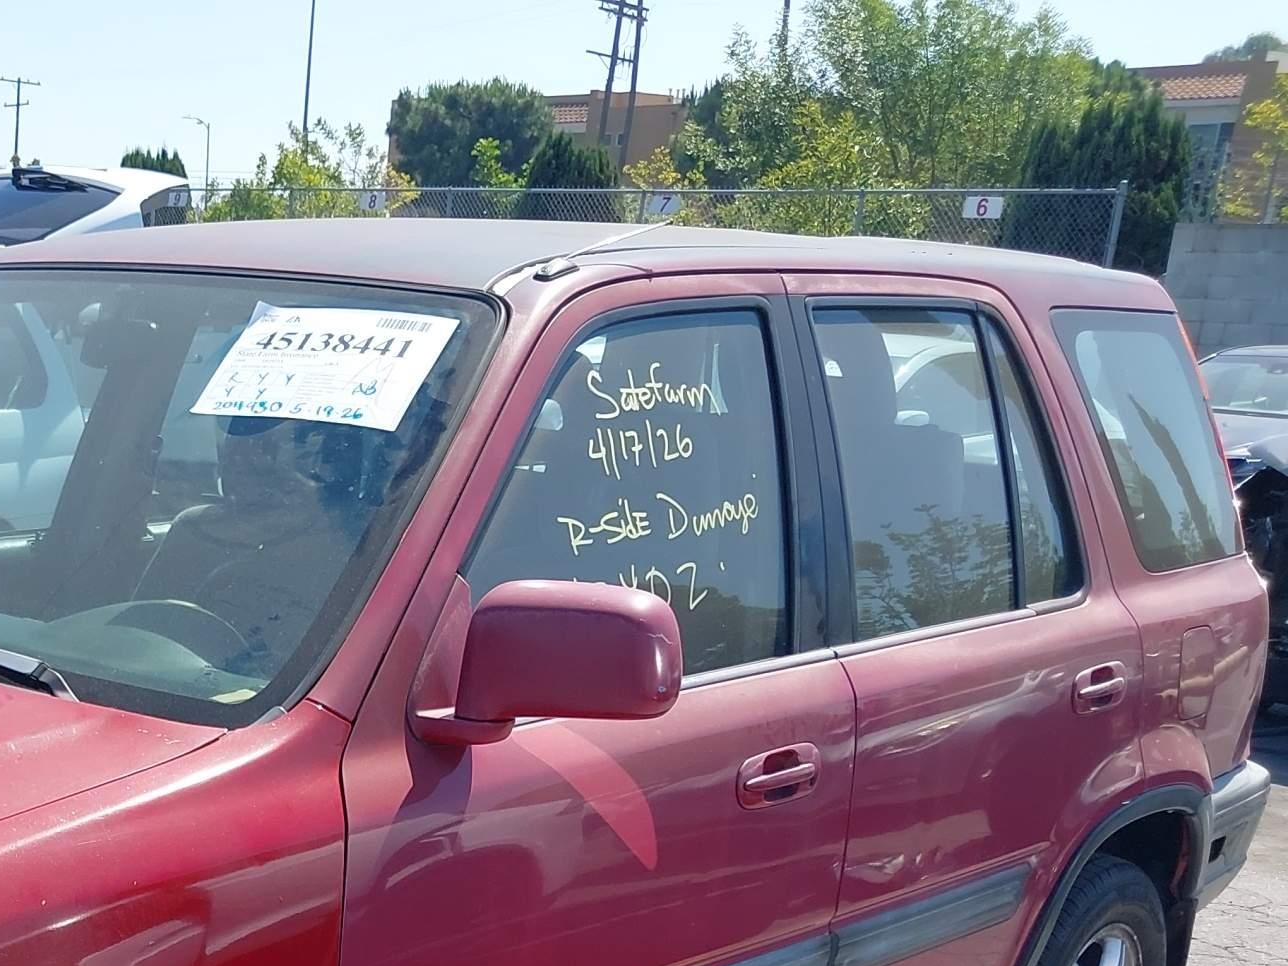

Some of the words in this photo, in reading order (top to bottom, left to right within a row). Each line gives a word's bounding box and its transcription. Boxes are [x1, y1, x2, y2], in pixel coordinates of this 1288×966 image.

[368, 194, 377, 209] 8
[660, 196, 672, 213] 7
[976, 198, 989, 217] 6
[255, 331, 414, 358] 45138441
[588, 419, 693, 480] 4/17/26
